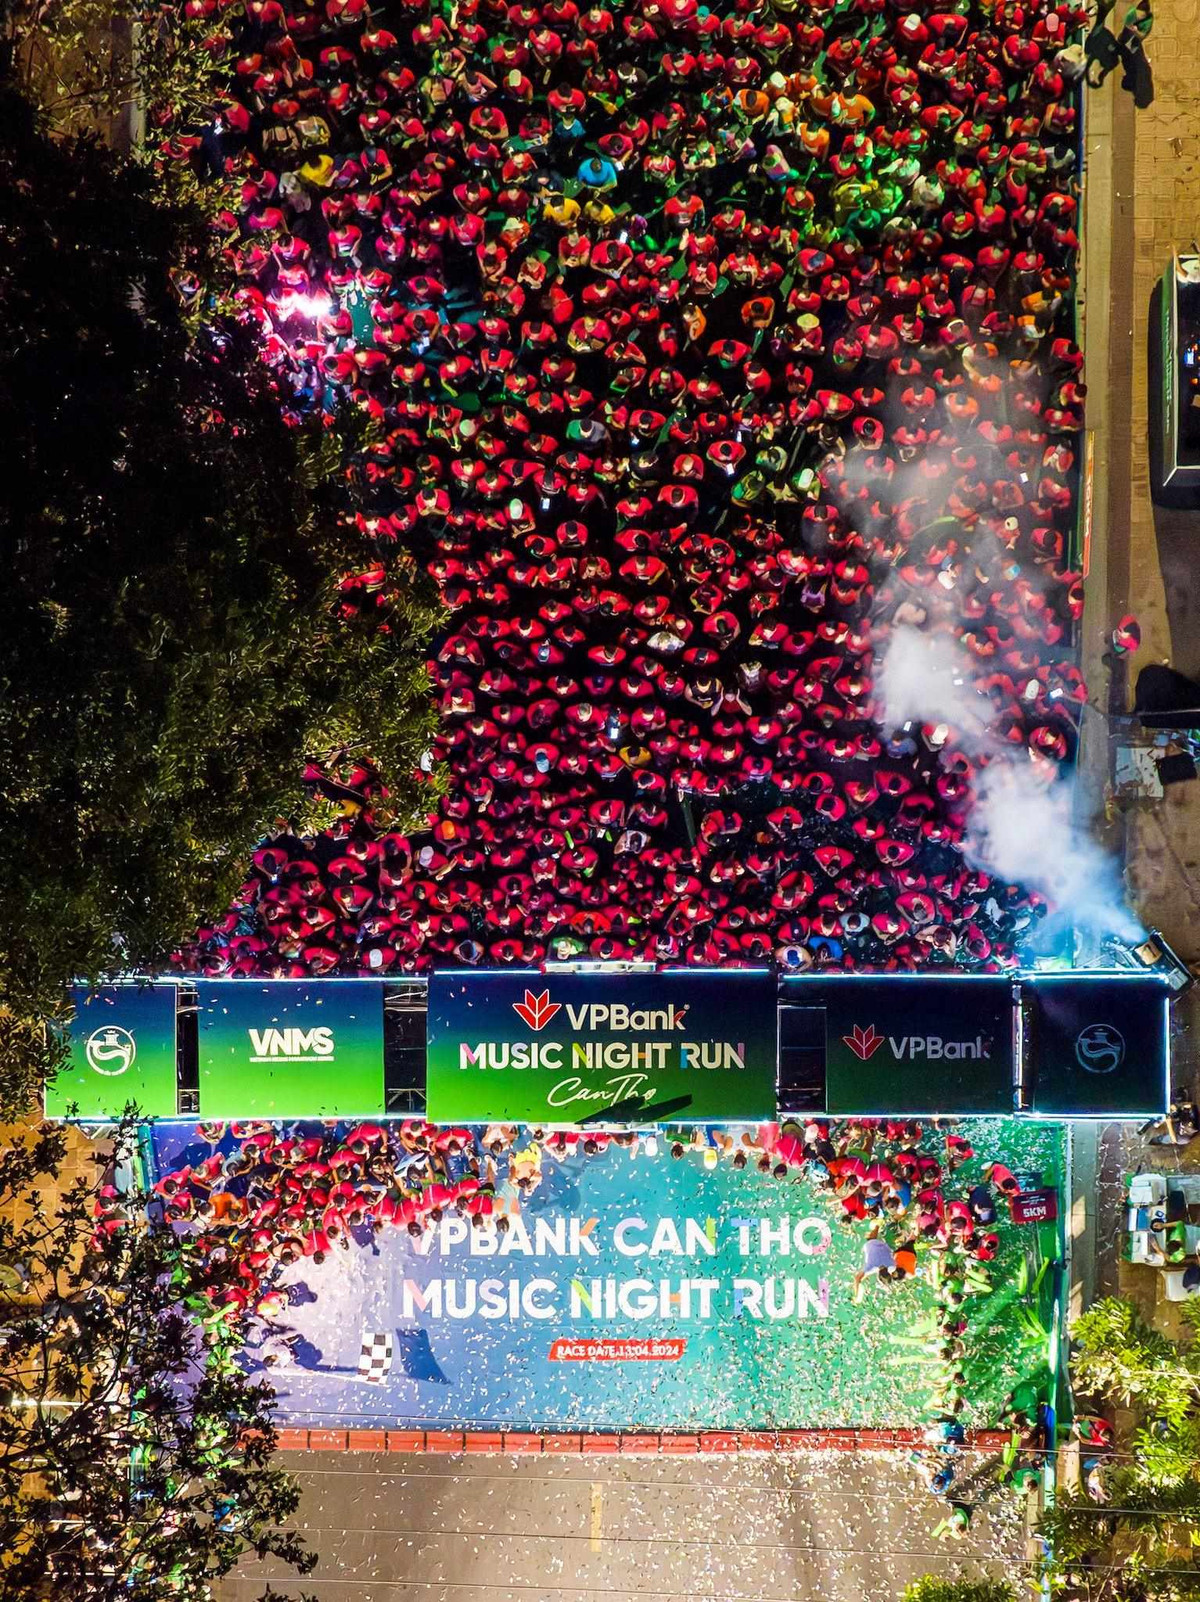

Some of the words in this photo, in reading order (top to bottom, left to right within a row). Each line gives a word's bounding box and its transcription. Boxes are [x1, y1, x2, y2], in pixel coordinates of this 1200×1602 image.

[565, 1003, 687, 1031] VPBank
[248, 1026, 335, 1056] VNMS
[889, 1035, 992, 1060] VPBank
[459, 1042, 563, 1070] MUSIC
[571, 1042, 672, 1070] NIGHT
[680, 1042, 746, 1070] RUN
[613, 1217, 717, 1256] CAN
[730, 1217, 832, 1256] THO
[402, 1278, 558, 1319] MUSIC
[571, 1278, 721, 1319] NIGHT
[733, 1278, 830, 1319] RUN
[557, 1345, 586, 1357] RACE
